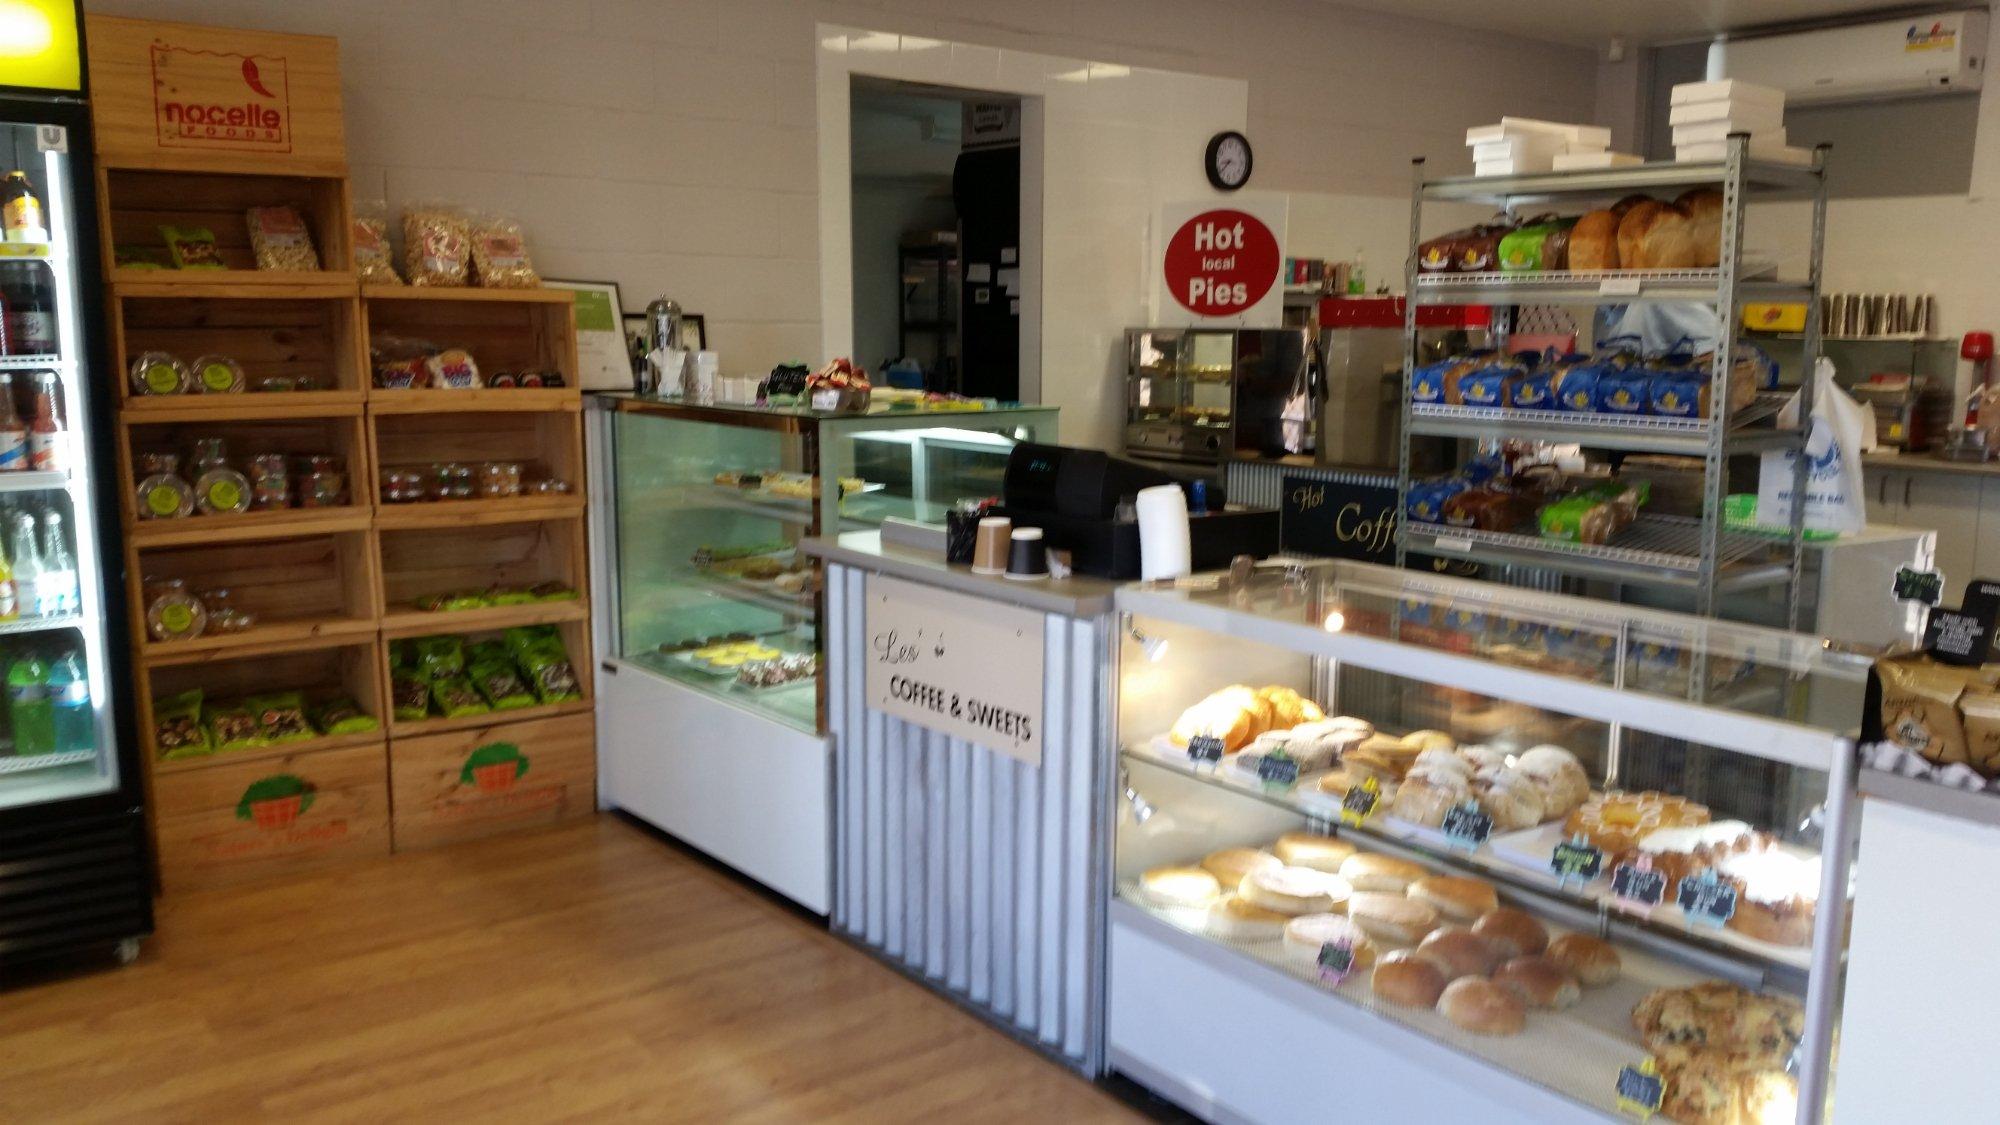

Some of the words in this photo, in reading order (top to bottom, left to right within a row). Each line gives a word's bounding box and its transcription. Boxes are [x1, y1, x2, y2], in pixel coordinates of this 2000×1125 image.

[165, 102, 281, 129] nocelle
[187, 125, 275, 139] FOODS
[1194, 221, 1245, 252] Hot
[1202, 254, 1235, 271] local
[1188, 276, 1248, 306] Pies
[1293, 484, 1325, 512] Hot
[890, 673, 945, 714] COFFEE
[950, 692, 962, 718] &
[967, 697, 1033, 742] SWEETS
